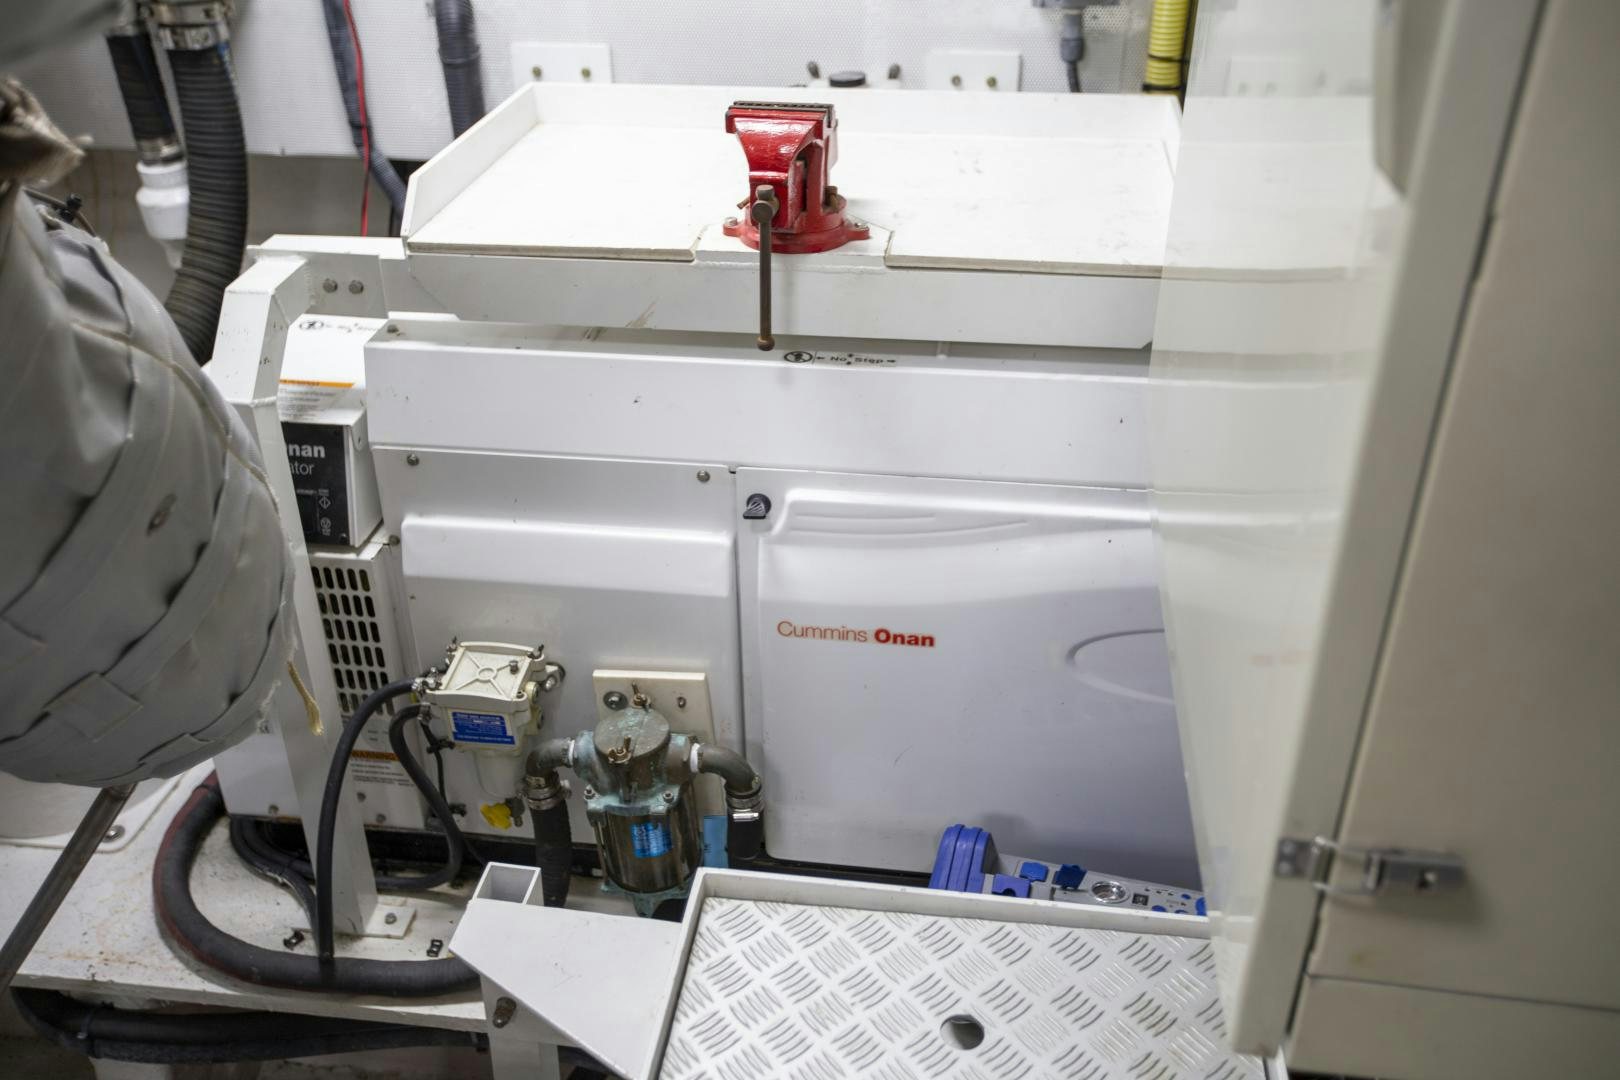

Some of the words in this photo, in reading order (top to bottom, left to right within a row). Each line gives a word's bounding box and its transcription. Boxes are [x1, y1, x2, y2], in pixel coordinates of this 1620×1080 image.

[854, 356, 884, 364] Step
[287, 443, 326, 459] nan
[776, 620, 868, 643] Cummins
[874, 628, 935, 647] Onan
